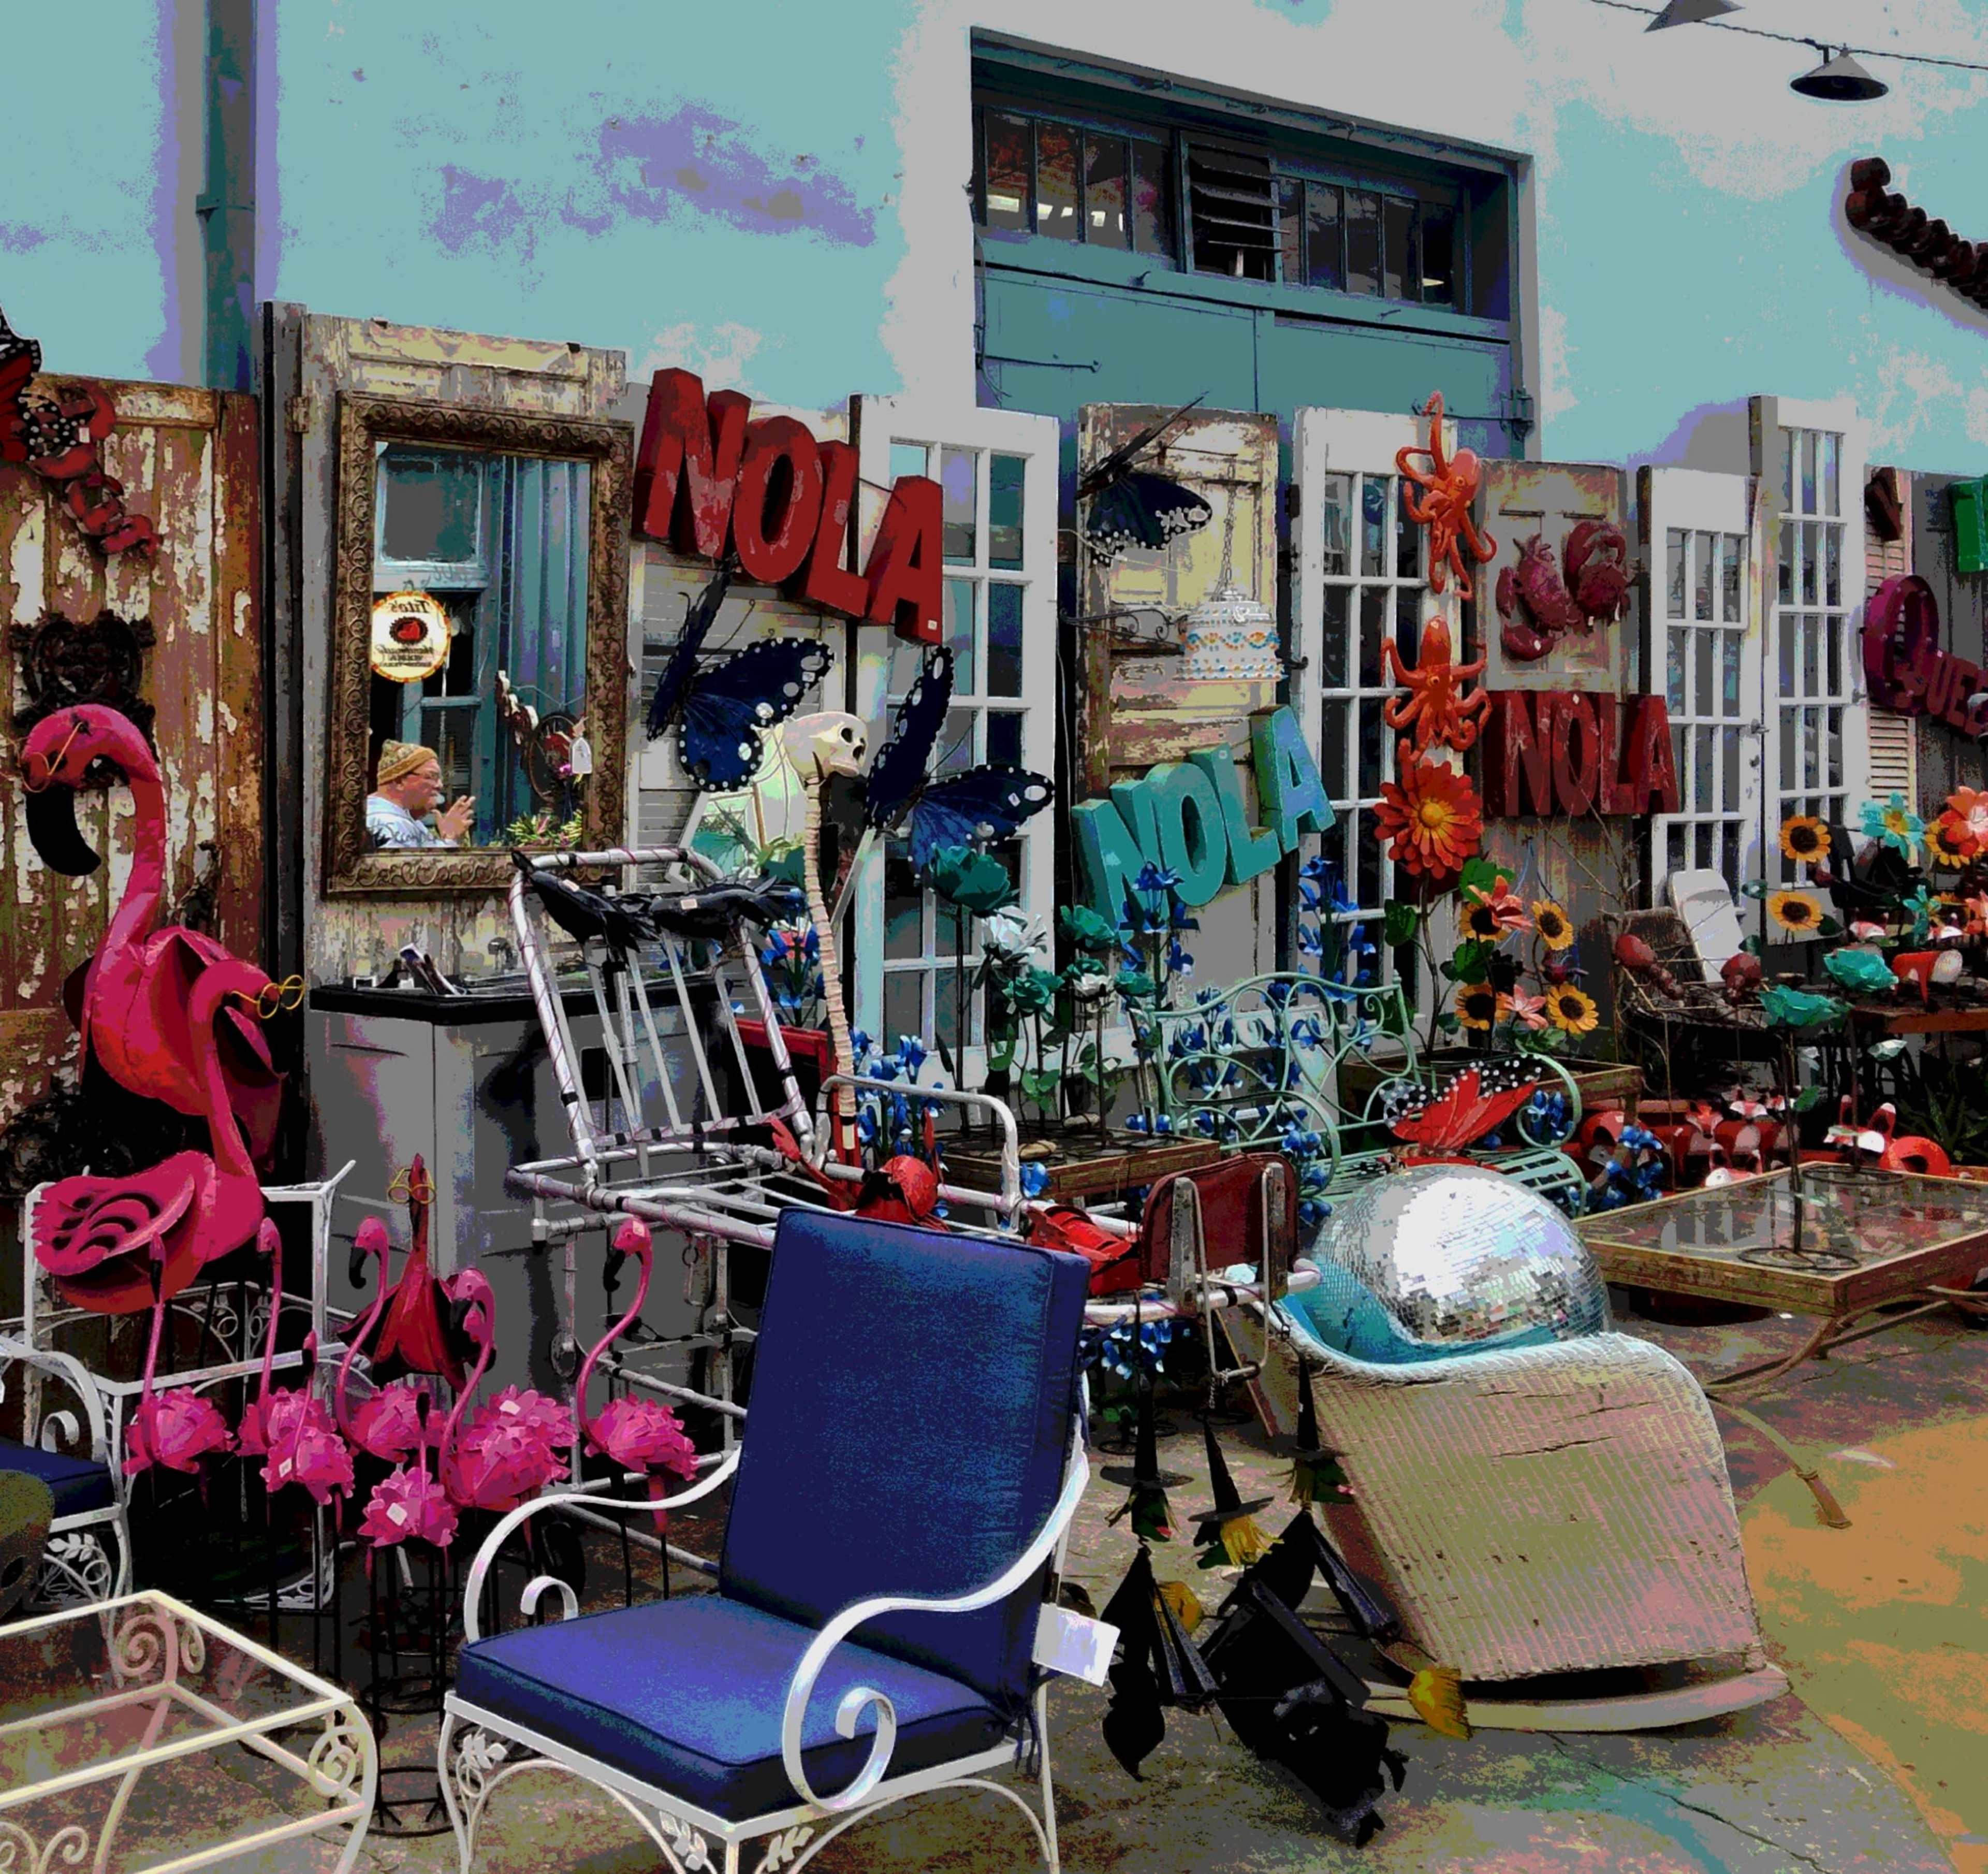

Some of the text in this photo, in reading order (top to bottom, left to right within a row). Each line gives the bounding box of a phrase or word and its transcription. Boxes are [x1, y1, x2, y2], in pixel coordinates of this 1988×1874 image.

[632, 367, 943, 646] NOLA
[1071, 704, 1336, 943] NOLA
[1491, 690, 1680, 817] NOLA
